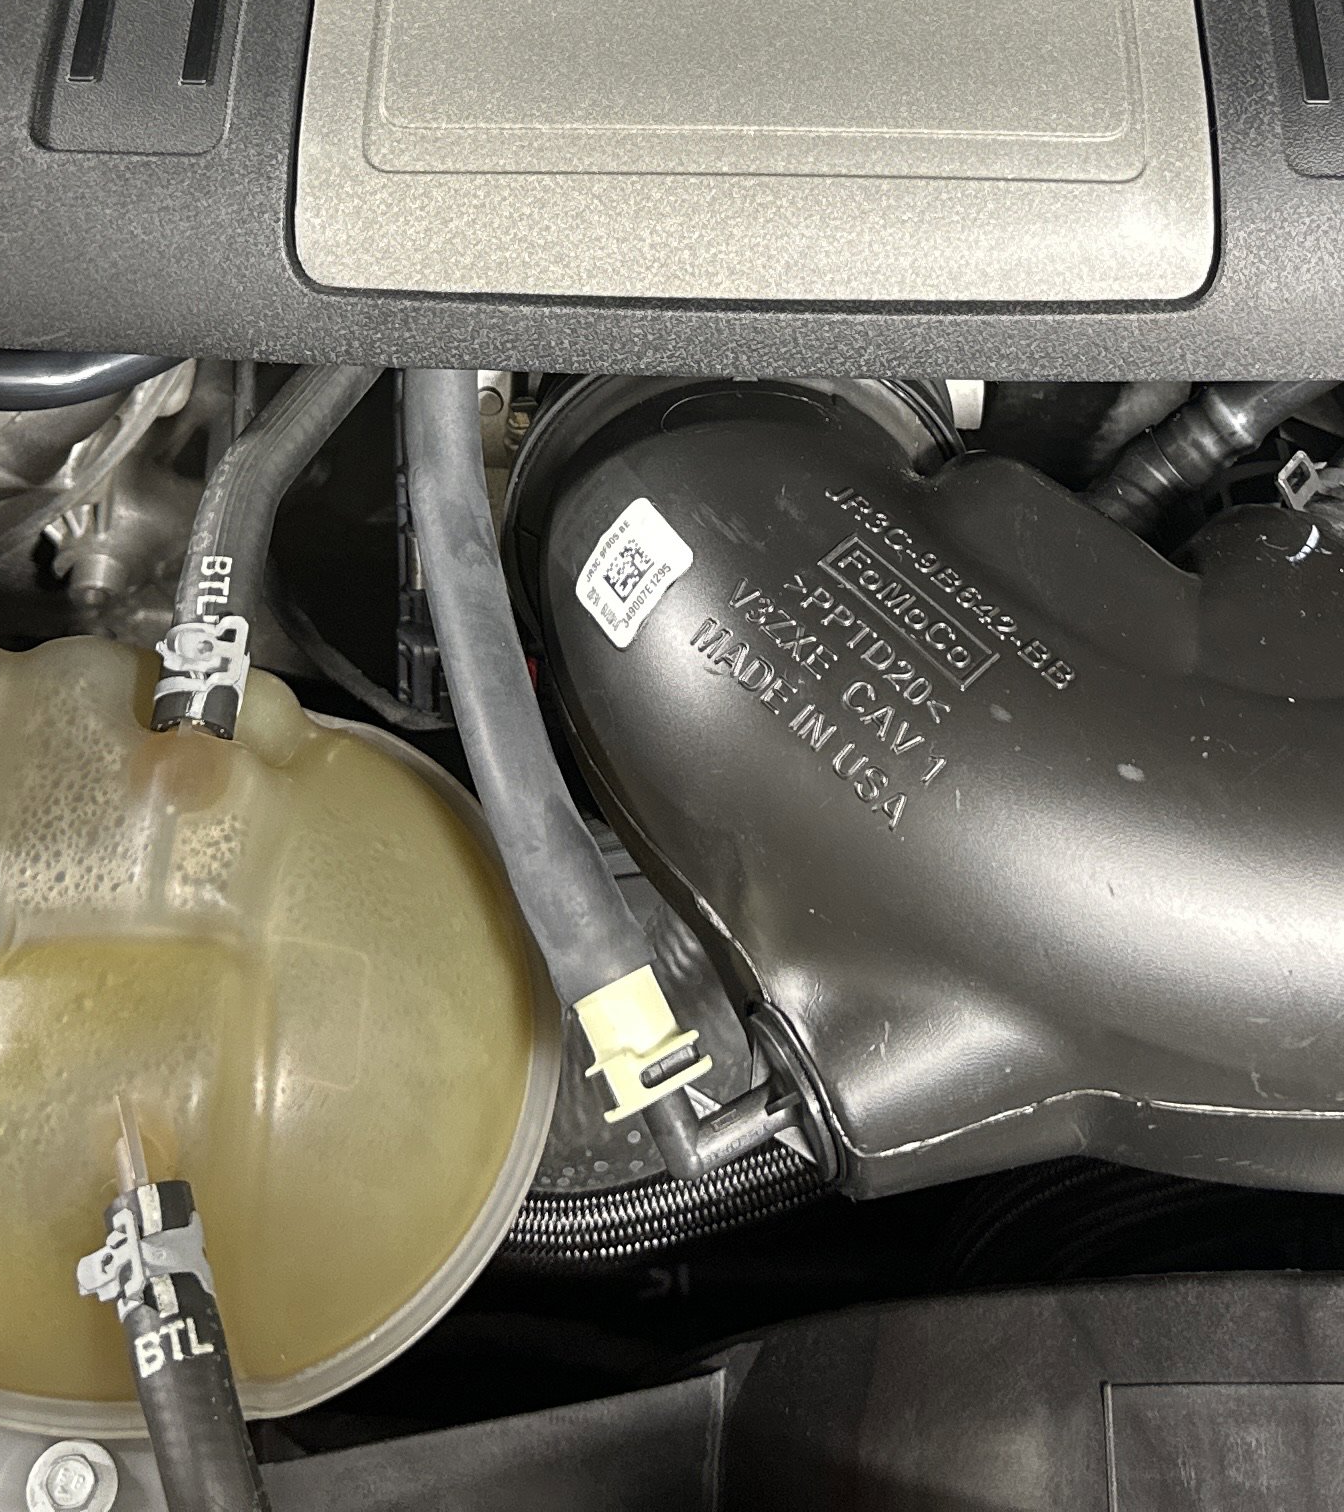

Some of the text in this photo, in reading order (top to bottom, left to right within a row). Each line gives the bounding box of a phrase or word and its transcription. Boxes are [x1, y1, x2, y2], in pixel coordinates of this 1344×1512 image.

[196, 555, 233, 615] BTL
[621, 562, 672, 629] 349007E1295
[825, 487, 1077, 690] JR3C-9B642-BB
[838, 549, 974, 670] FoMoCo
[689, 617, 909, 831] MADE IN USA
[725, 578, 948, 786] V3ZXE CAV 1
[134, 1316, 214, 1378] BTL
